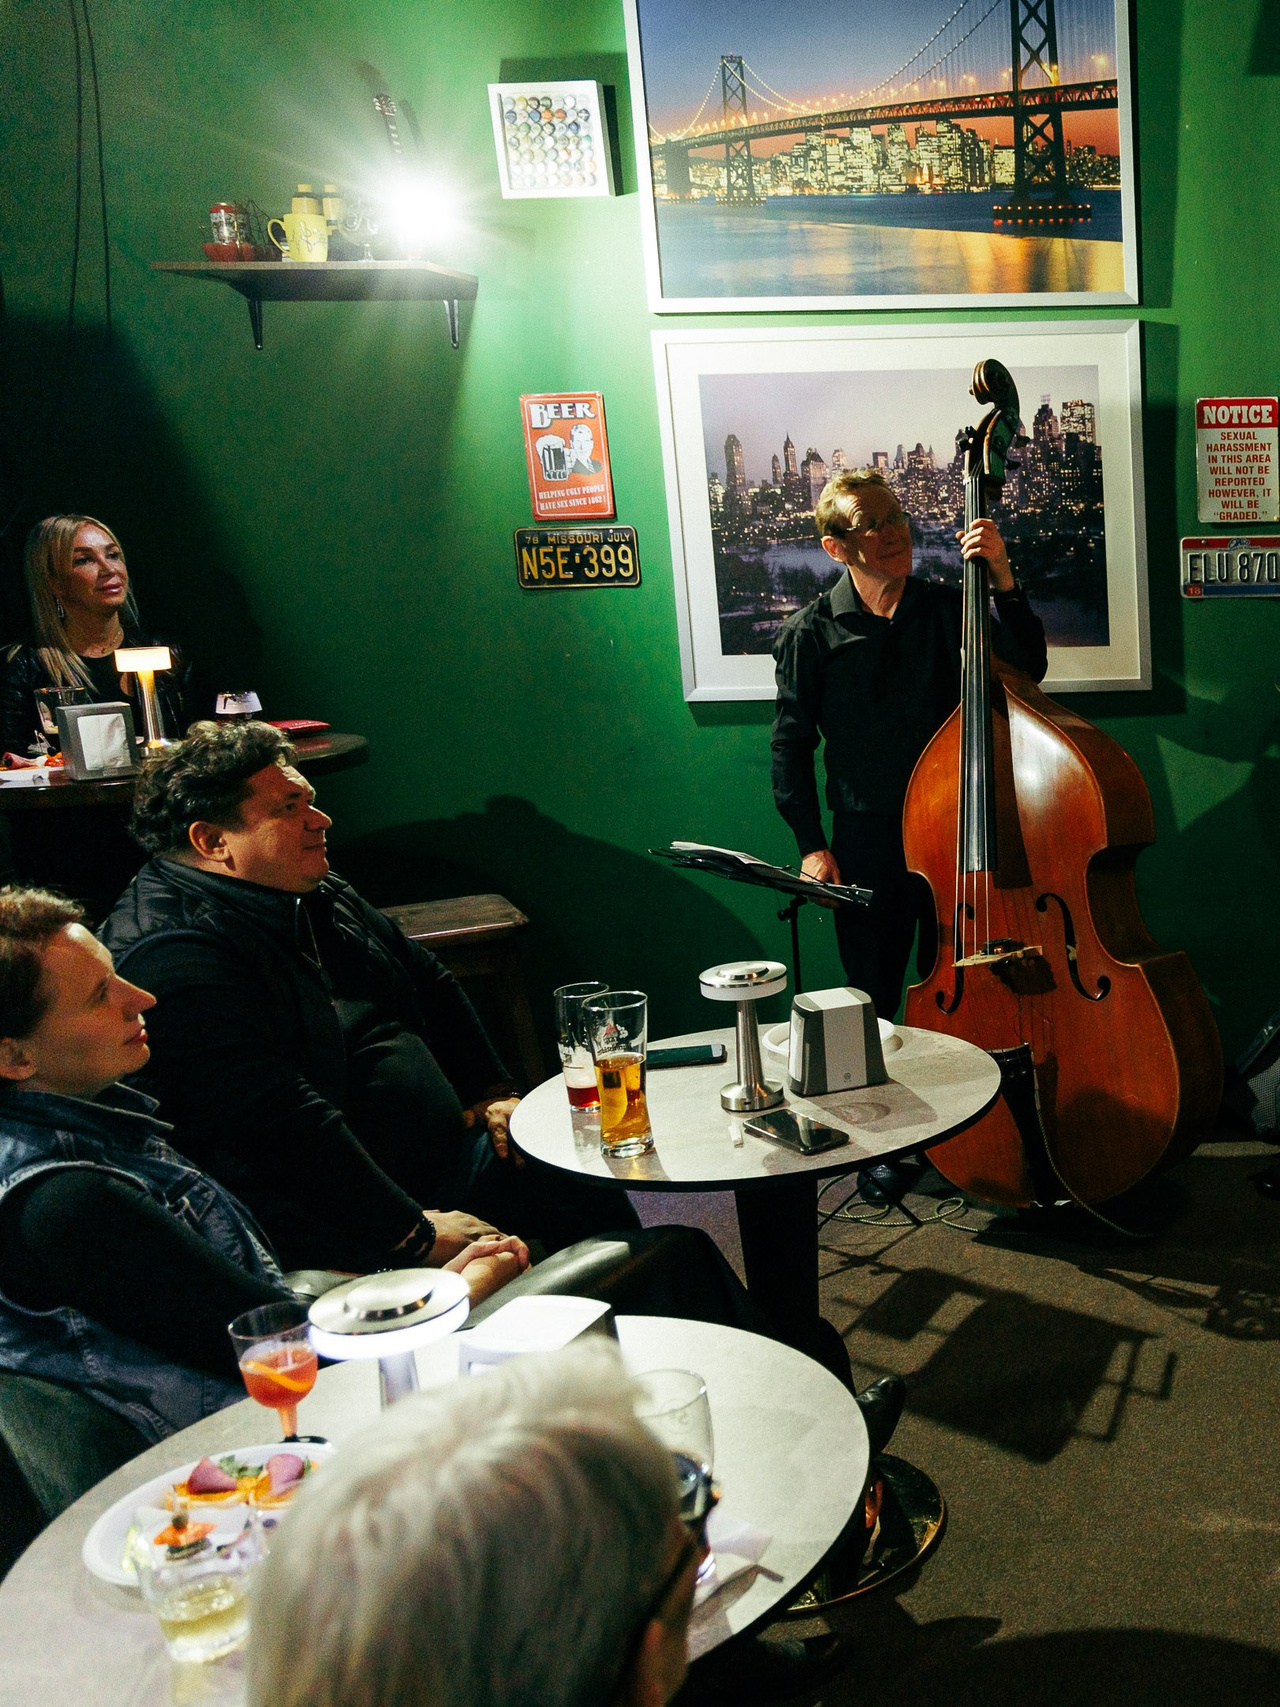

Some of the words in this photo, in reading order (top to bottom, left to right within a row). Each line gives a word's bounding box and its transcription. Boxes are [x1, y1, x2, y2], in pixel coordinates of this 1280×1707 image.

[528, 402, 596, 429] BEER
[1203, 405, 1273, 424] NOTICE
[1220, 431, 1257, 441] SEXUAL
[1206, 443, 1272, 452] HARASSMENT
[1208, 455, 1218, 463] IN
[1221, 454, 1242, 463] THIS
[1246, 454, 1271, 463] AREA
[1209, 466, 1232, 475] WILL
[1235, 466, 1254, 475] NOT
[1257, 465, 1270, 474] BE
[1214, 477, 1265, 486] REPORTED
[538, 489, 565, 500] HELPING
[566, 487, 581, 496] UGLY
[582, 484, 605, 494] PEOPLE
[1208, 489, 1259, 498] HOWEVER,
[1263, 488, 1272, 497] IT
[540, 501, 557, 511] HAVE
[557, 499, 568, 508] SEX
[568, 497, 587, 507] SINCE
[1221, 500, 1244, 509] WILL
[1247, 500, 1260, 509] BE
[547, 532, 603, 544] MISSOURI
[607, 532, 630, 542] JULY
[1187, 551, 1230, 584] ELU
